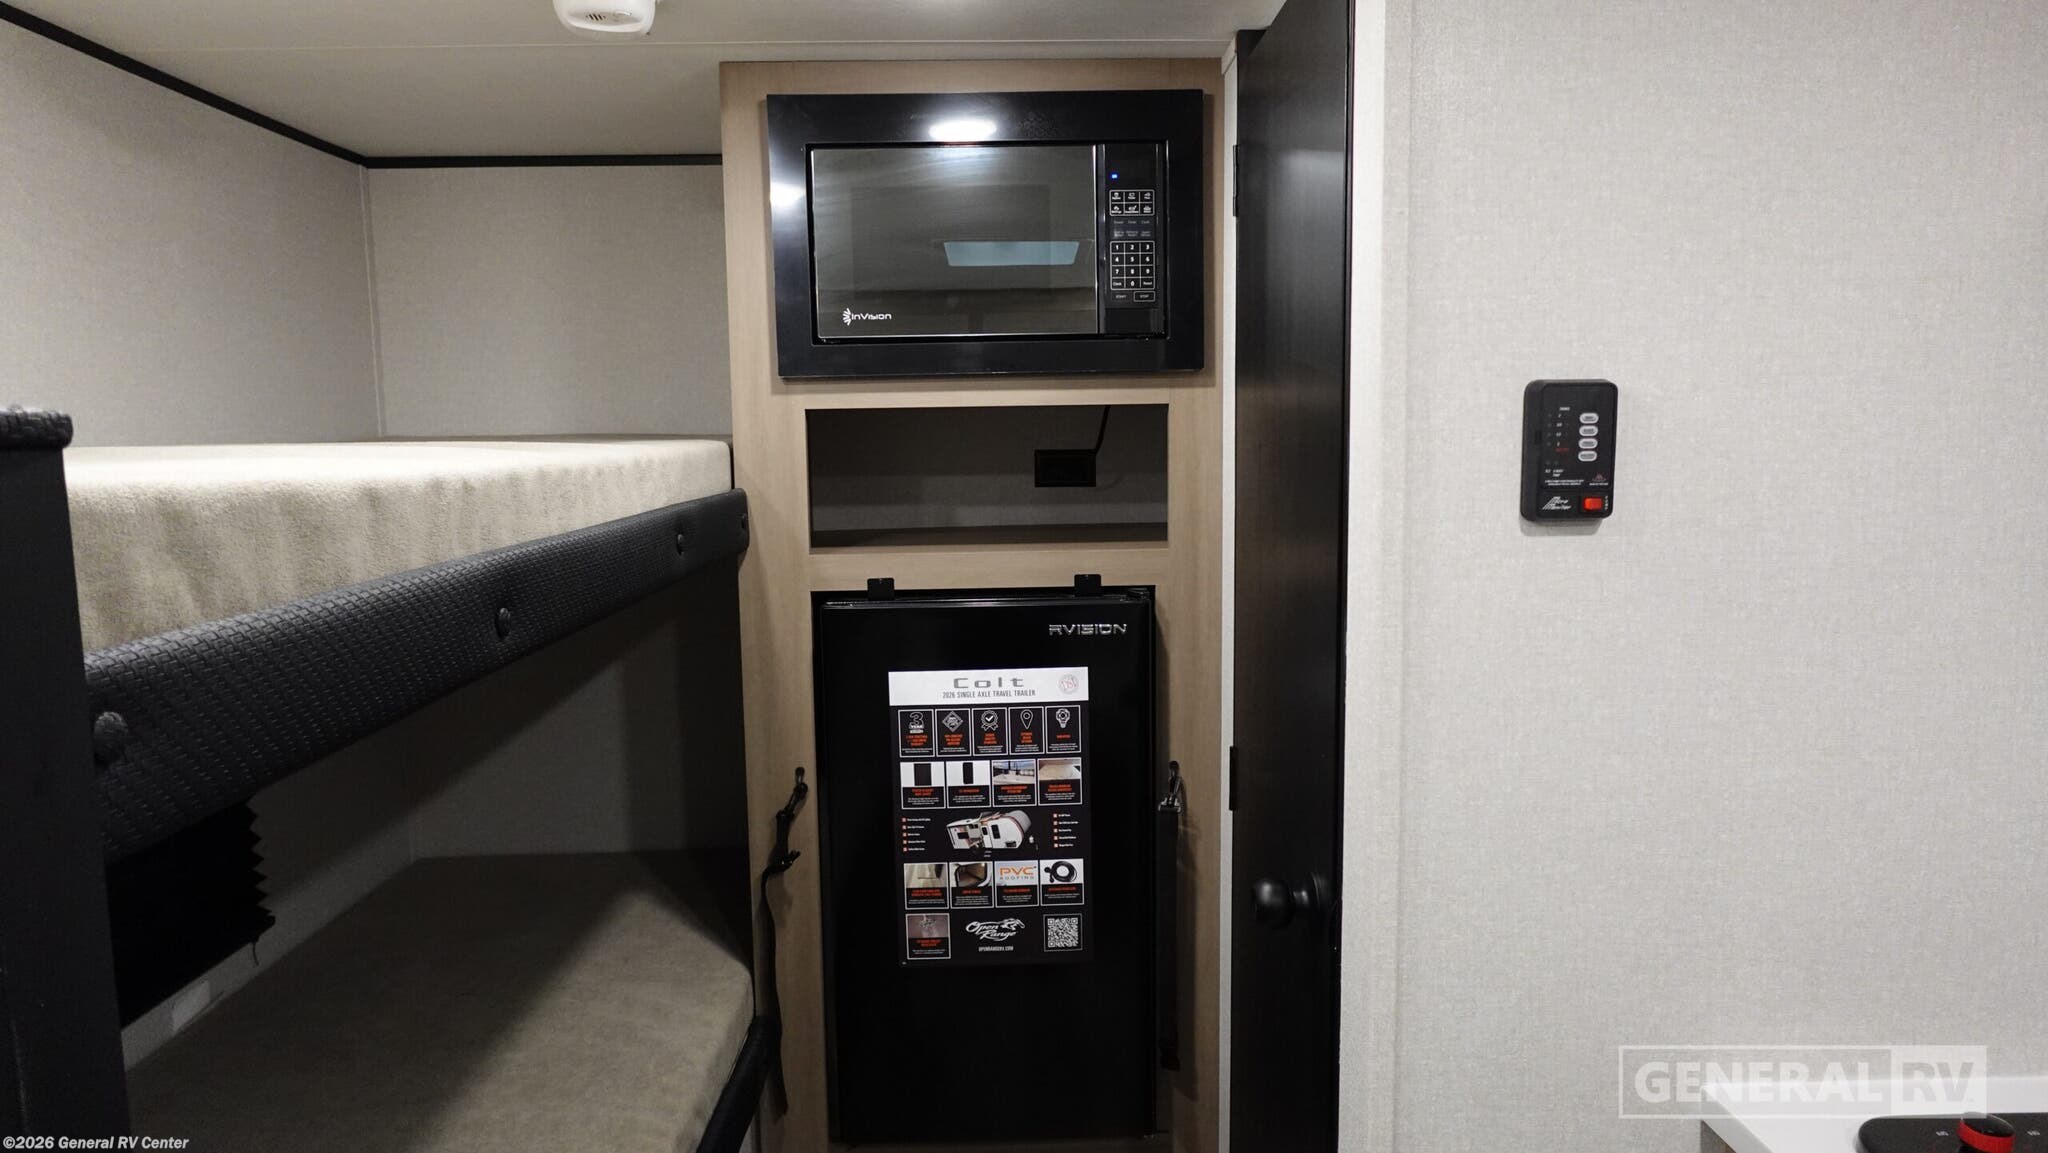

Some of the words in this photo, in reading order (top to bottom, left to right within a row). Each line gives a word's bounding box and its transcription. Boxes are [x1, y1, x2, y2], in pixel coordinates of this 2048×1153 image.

[1048, 623, 1127, 636] RVISION
[953, 676, 1025, 689] Colt
[943, 691, 956, 699] 2026
[909, 711, 924, 728] 3
[1000, 866, 1034, 876] PVC
[966, 921, 999, 935] Open
[979, 930, 1017, 941] Range
